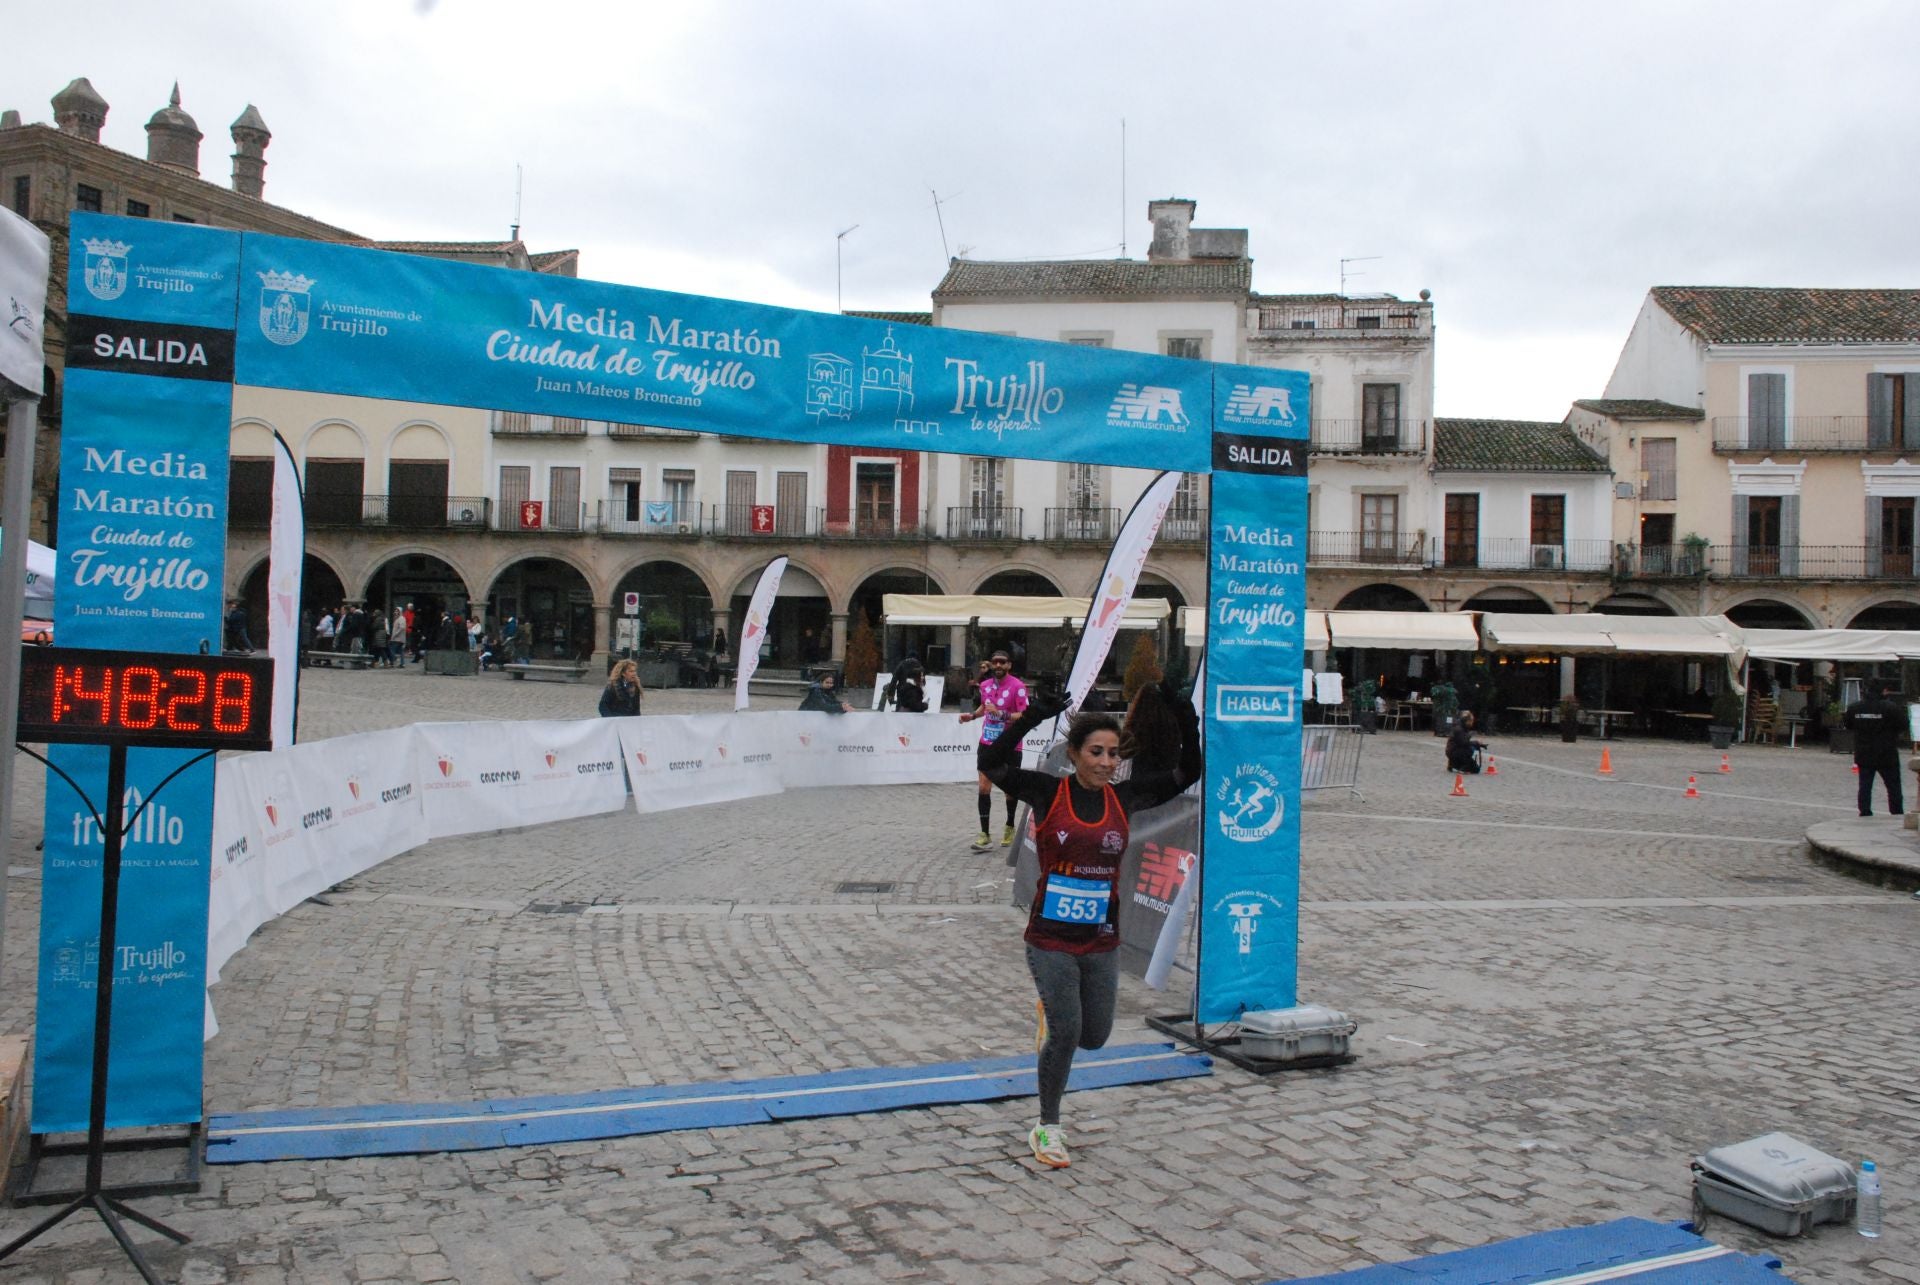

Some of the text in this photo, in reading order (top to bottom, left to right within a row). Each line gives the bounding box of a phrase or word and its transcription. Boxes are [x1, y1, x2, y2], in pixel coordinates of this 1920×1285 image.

[136, 263, 224, 281] Ayuntamiento de
[135, 275, 194, 294] Trujillo
[321, 300, 423, 322] Ayuntamiento de
[319, 315, 388, 337] Trujillo
[527, 298, 782, 359] Media Maratón
[94, 333, 208, 366] SALIDA
[486, 329, 756, 396] Ciudad de Trujillo
[535, 376, 702, 407] Juan Mateos Broncano
[945, 356, 1064, 425] Trujillo
[970, 410, 985, 431] te
[1106, 418, 1187, 433] www.musicrun.es
[1223, 414, 1293, 428] www.musicrun.es
[83, 447, 208, 480] Media
[1228, 445, 1293, 466] SALIDA
[73, 487, 216, 519] Maratón
[91, 524, 196, 549] Ciudad de
[1223, 524, 1294, 547] Media
[70, 549, 209, 602] Trujillo
[1218, 553, 1299, 575] Maratón
[1227, 579, 1285, 597] Ciudad de
[75, 604, 205, 620] Juan Mateos Broncano
[1216, 597, 1295, 635] Trujillo
[1219, 637, 1236, 646] Juan
[1236, 637, 1262, 647] Mateos
[53, 665, 252, 733] 1:48:28
[1226, 696, 1282, 712] HABLA
[1216, 762, 1280, 801] Club Atletismo
[1056, 896, 1098, 920] 553
[117, 941, 186, 971] Trujillo
[138, 969, 149, 983] te
